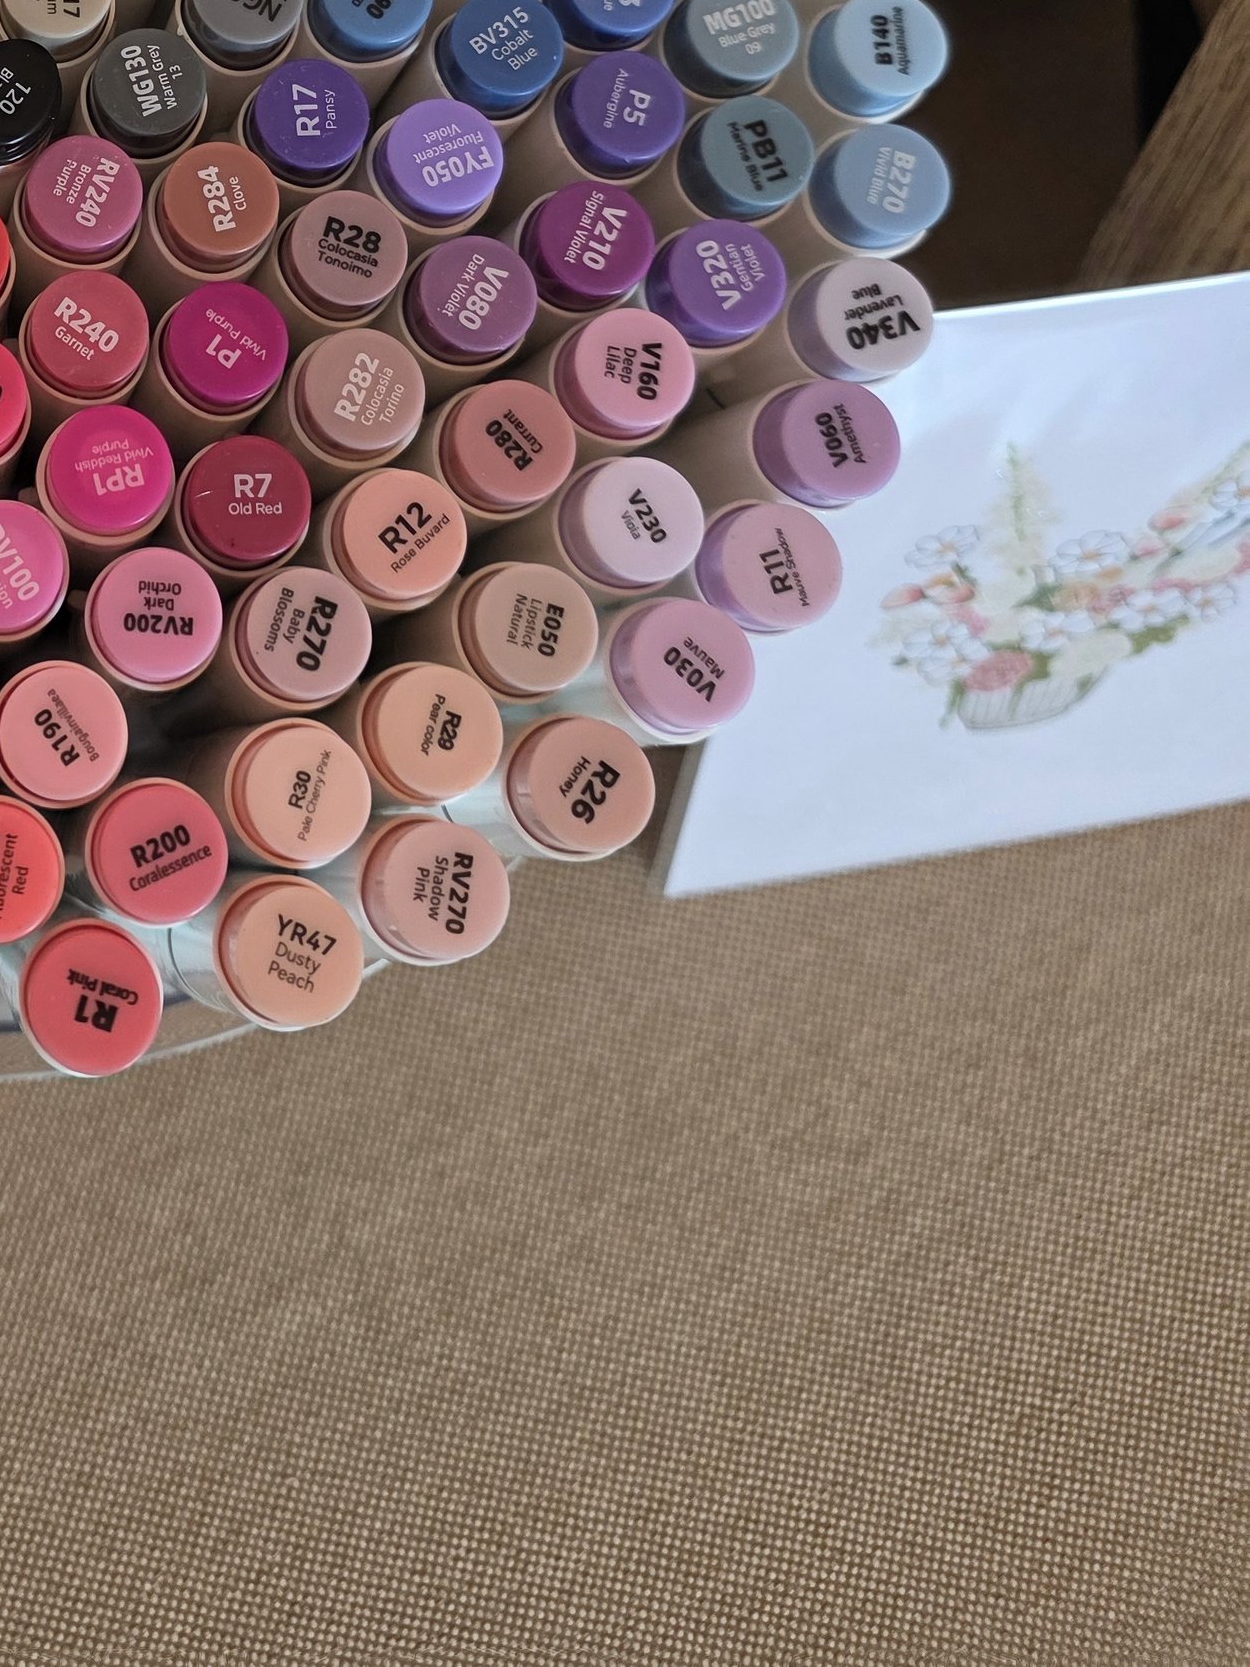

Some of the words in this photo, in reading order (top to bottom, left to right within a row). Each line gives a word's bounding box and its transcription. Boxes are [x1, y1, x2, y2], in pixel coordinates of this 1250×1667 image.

[469, 7, 533, 55] BV315
[491, 28, 533, 62] Cobalt
[871, 15, 893, 65] B140
[507, 48, 537, 70] Blue
[296, 84, 321, 137] R17
[325, 90, 337, 128] Pansy
[623, 90, 651, 126] P5
[198, 166, 238, 231] R284
[883, 151, 916, 213] B270
[318, 216, 381, 253] R28
[54, 297, 118, 357] R240
[55, 326, 94, 360] Garnet
[847, 310, 921, 349] V340
[604, 346, 620, 378] Lilac
[618, 347, 637, 384] Deep
[637, 343, 662, 400] V160
[486, 415, 537, 471] R280
[815, 413, 849, 468] V060
[228, 501, 252, 515] Old
[255, 501, 282, 515] Red
[234, 474, 272, 498] R7
[378, 502, 434, 557] R12
[139, 581, 181, 595] Orchid
[144, 597, 174, 611] Dark
[124, 613, 193, 636] RV200
[664, 641, 723, 702] V030
[35, 709, 80, 766] R190
[572, 760, 620, 824] R26
[129, 840, 212, 891] Coralessence
[130, 825, 190, 868] R200
[275, 914, 336, 961] YR47
